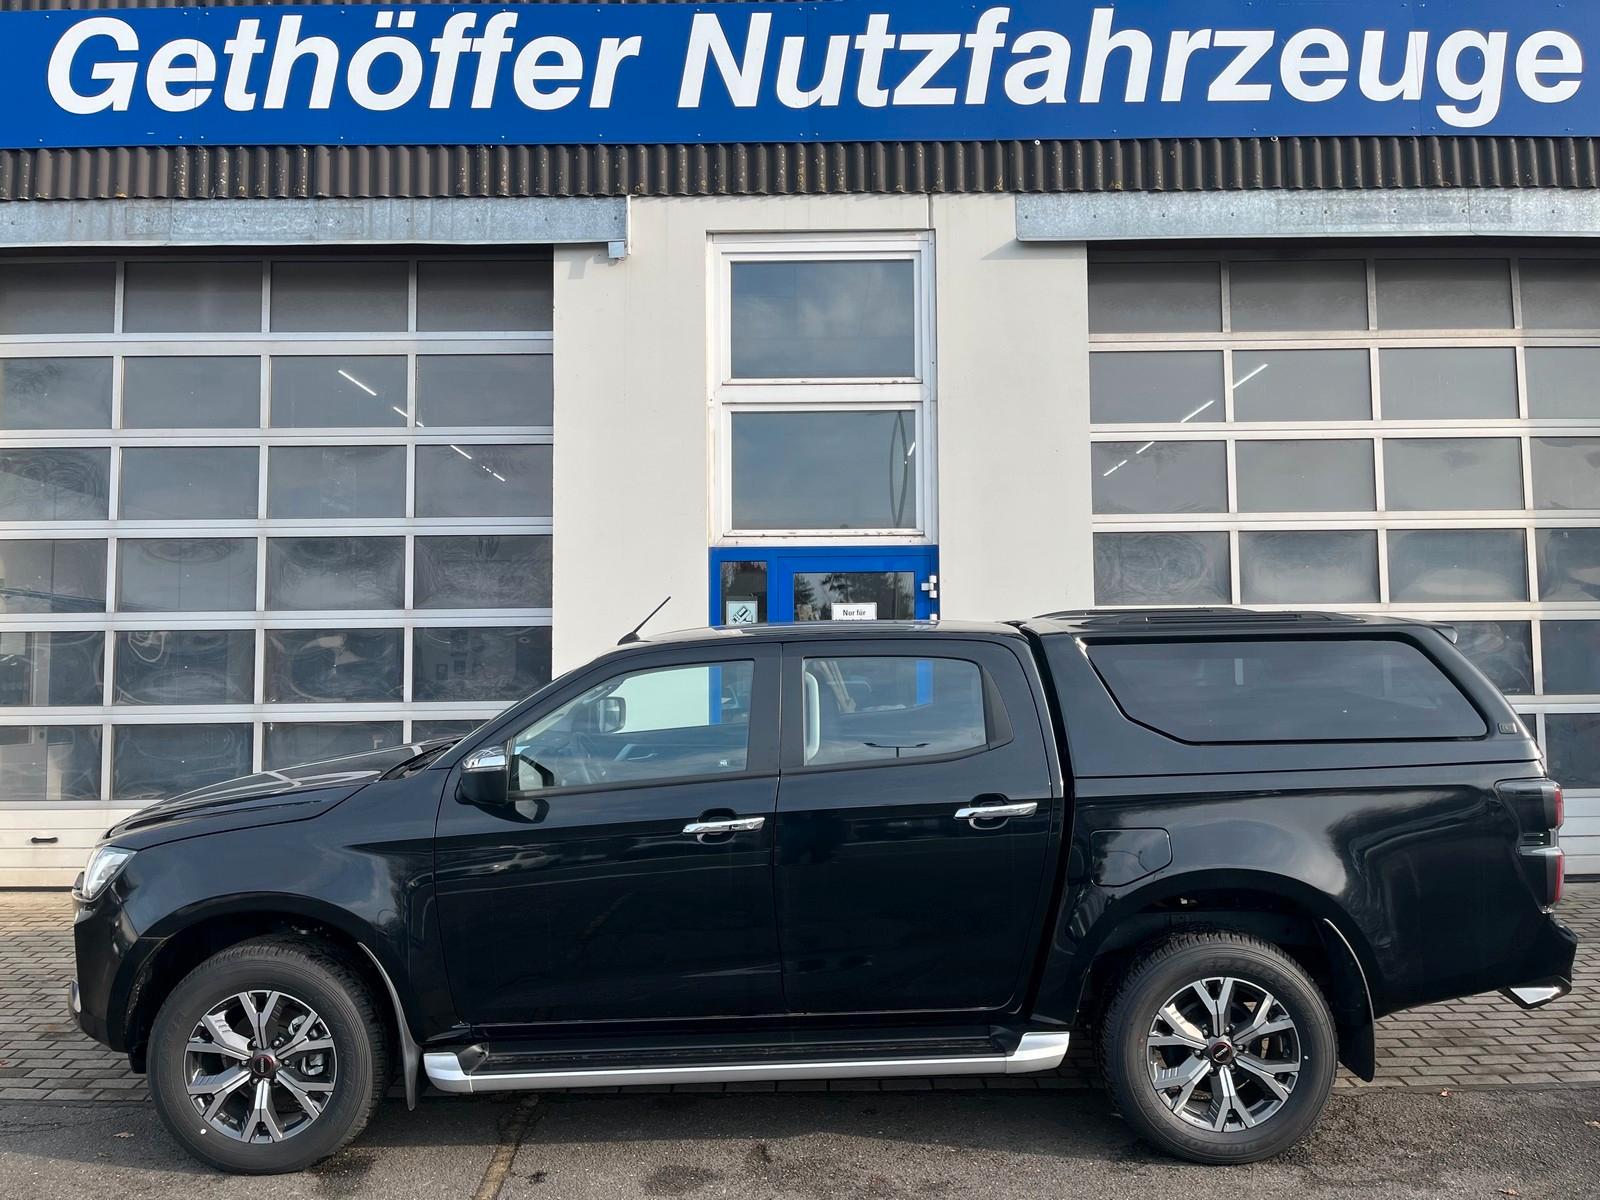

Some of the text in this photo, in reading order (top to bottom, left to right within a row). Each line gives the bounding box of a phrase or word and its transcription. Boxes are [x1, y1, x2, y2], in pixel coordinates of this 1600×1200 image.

[47, 6, 1583, 128] Gethöffer Nutzfahrzeuge
[842, 608, 866, 617] Nur für
